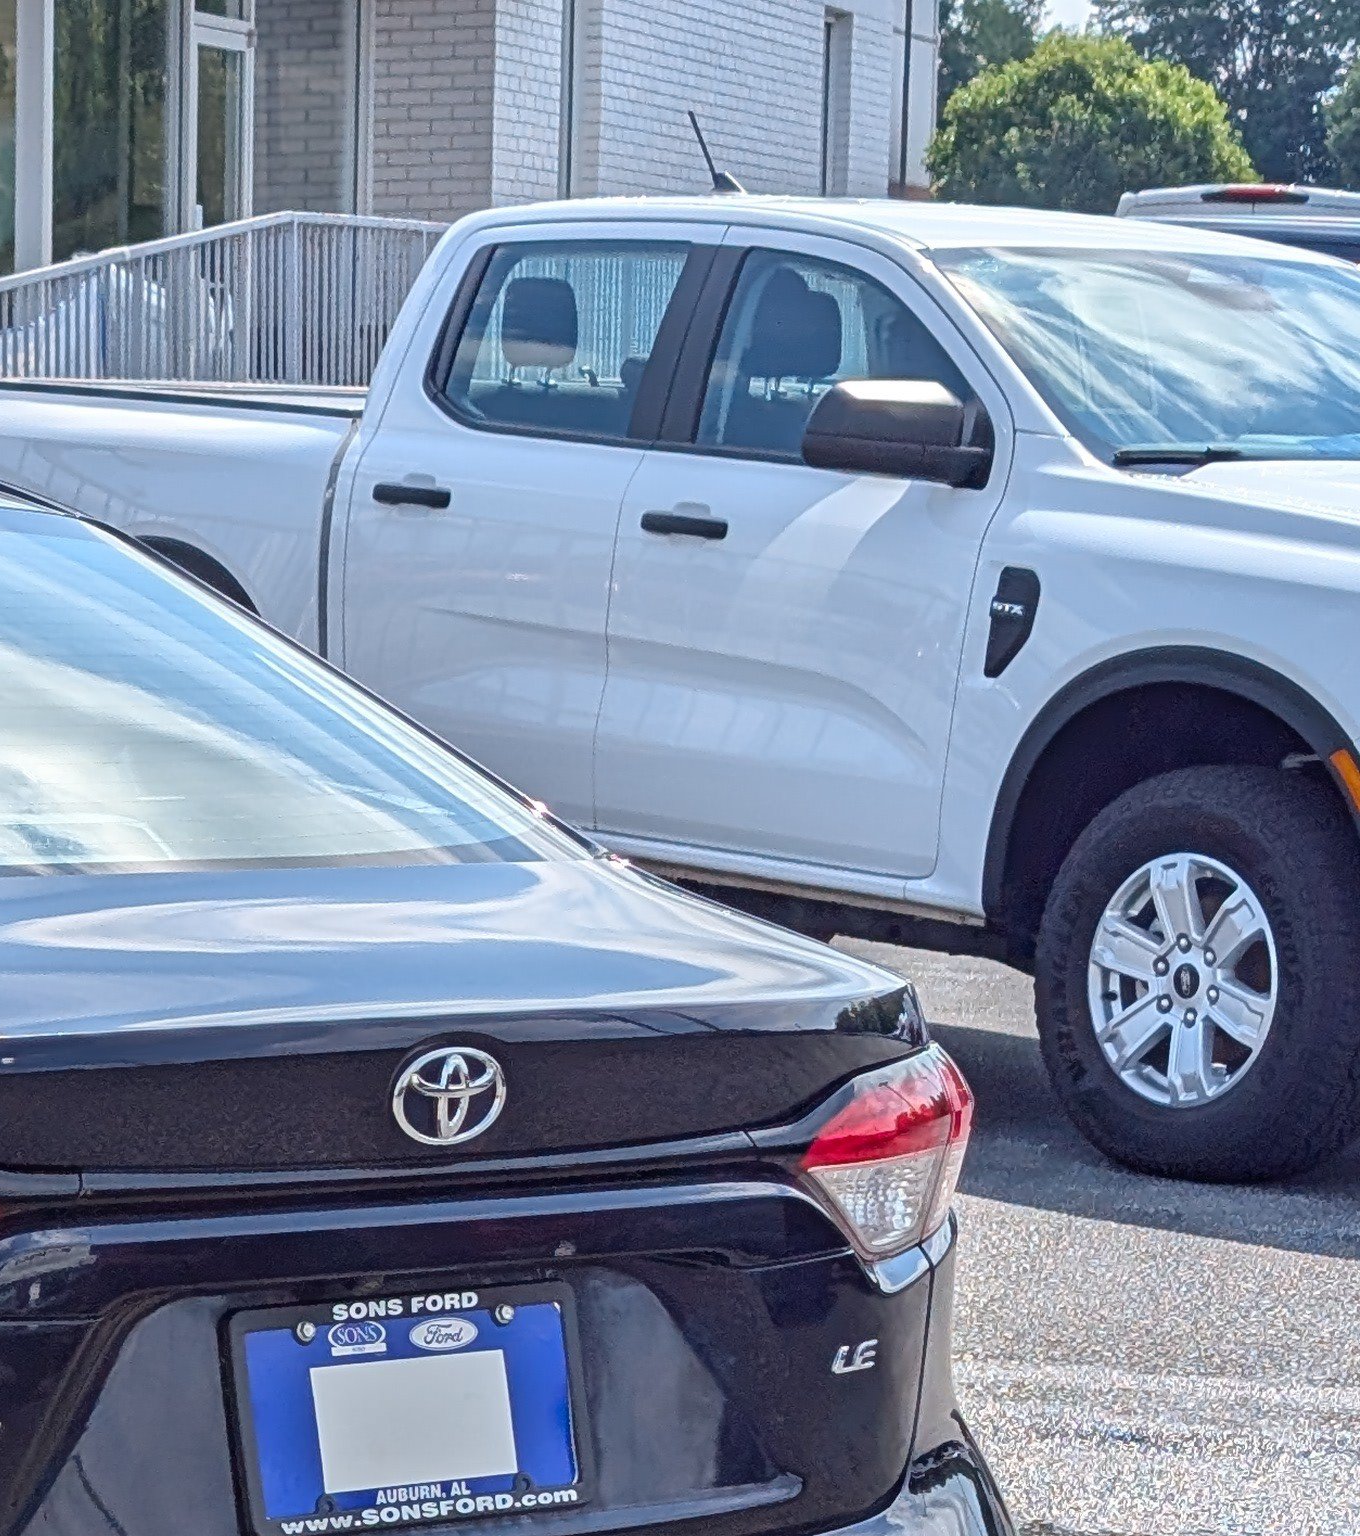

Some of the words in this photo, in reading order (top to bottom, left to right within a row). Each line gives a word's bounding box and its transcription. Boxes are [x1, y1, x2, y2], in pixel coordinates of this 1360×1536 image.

[332, 1299, 404, 1321] SONS
[411, 1291, 479, 1313] FORD
[336, 1325, 378, 1345] SONS
[423, 1323, 464, 1345] Ford
[831, 1339, 878, 1374] LE
[450, 1481, 471, 1496] AL
[280, 1487, 578, 1535] www.SONSFORD.com
